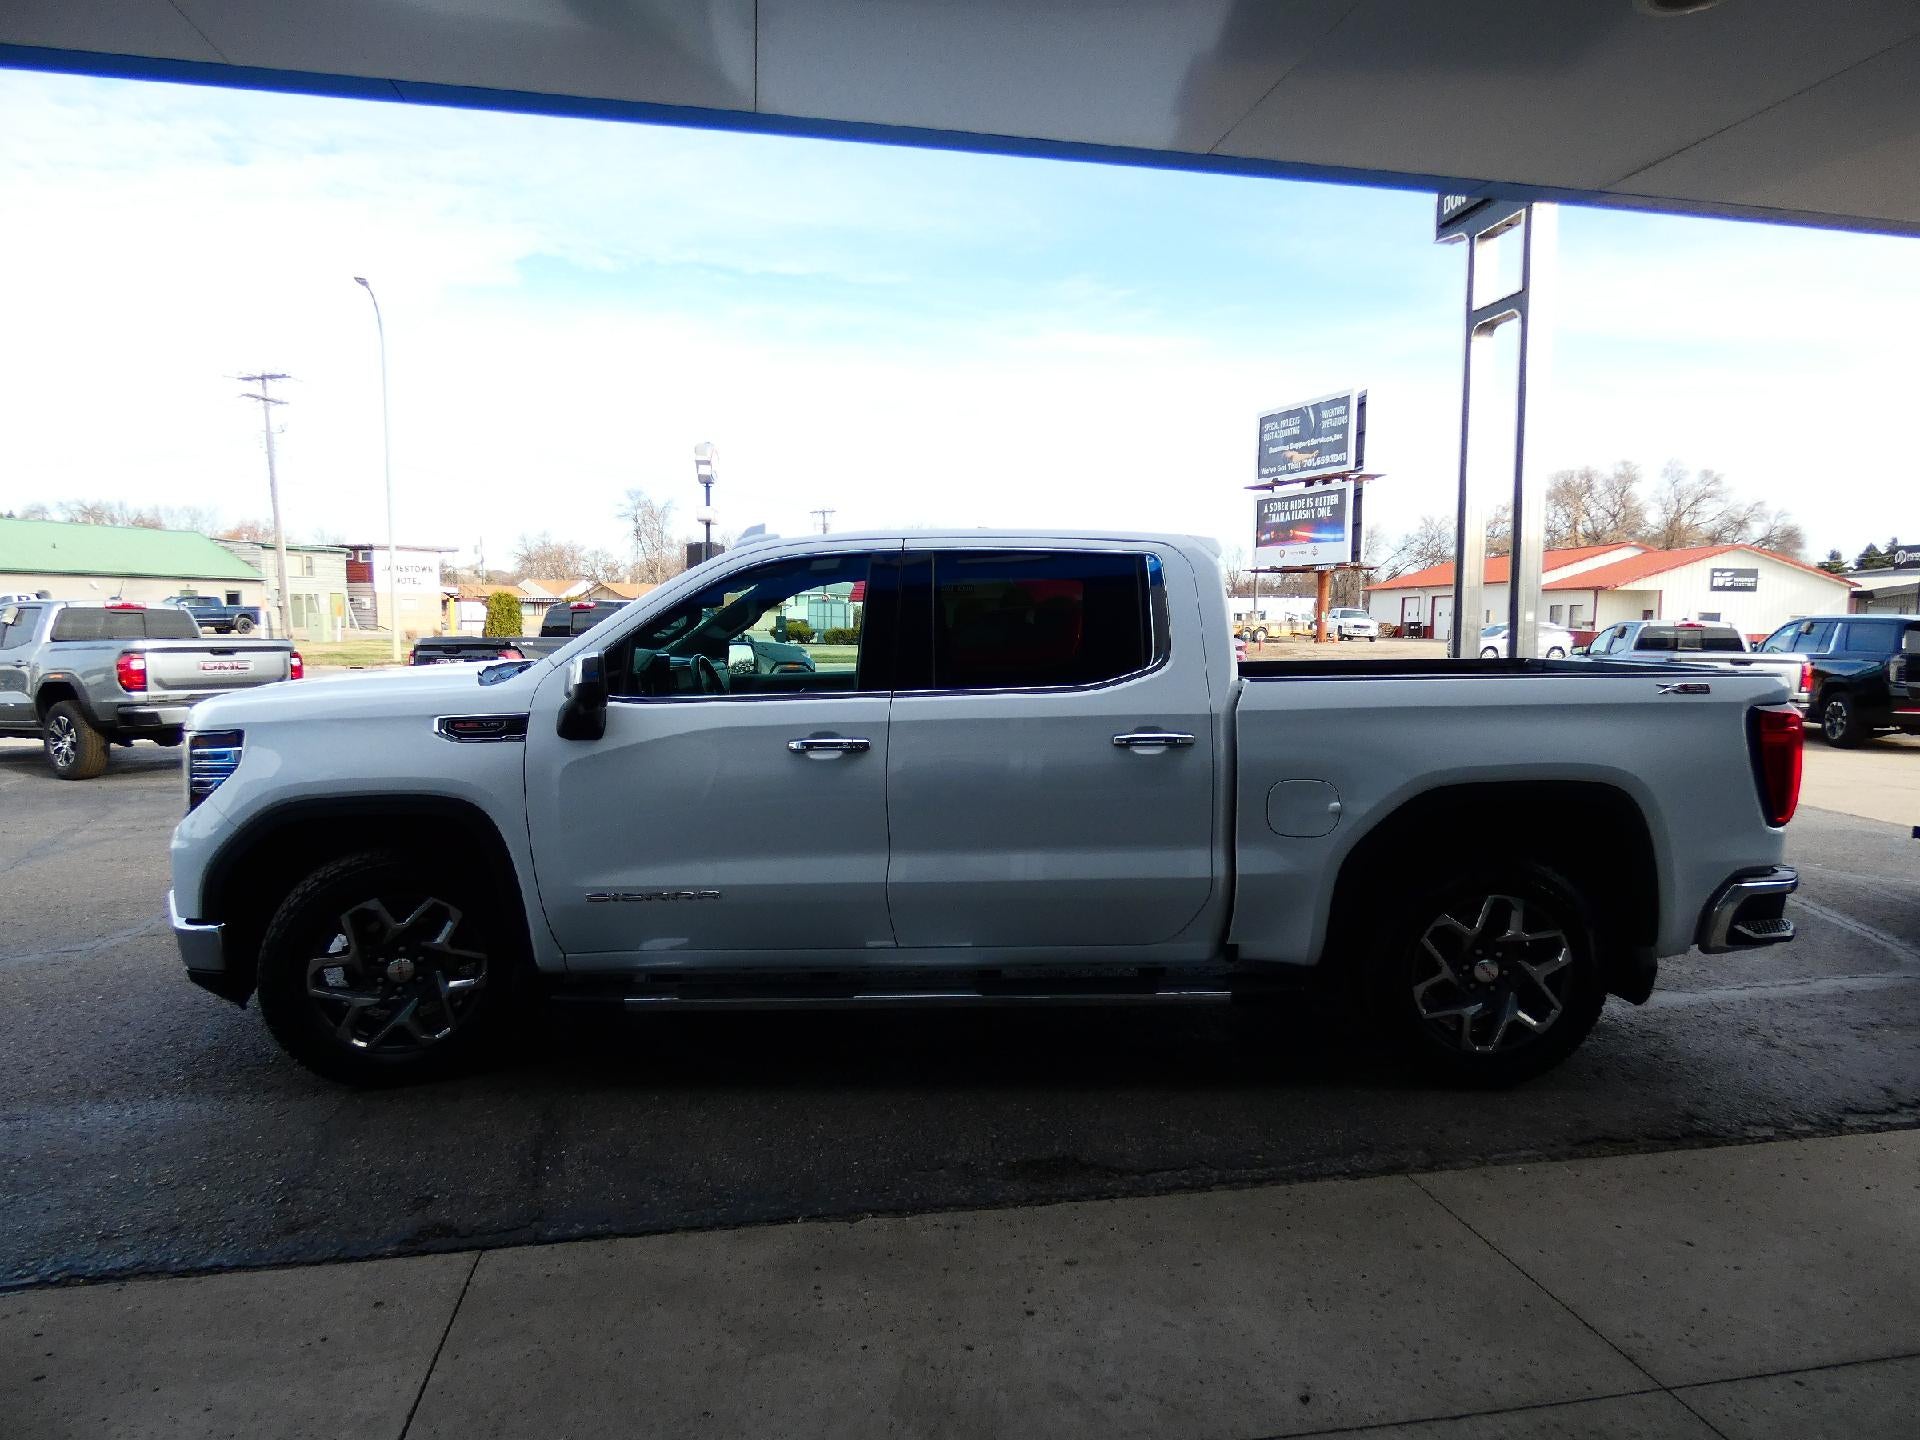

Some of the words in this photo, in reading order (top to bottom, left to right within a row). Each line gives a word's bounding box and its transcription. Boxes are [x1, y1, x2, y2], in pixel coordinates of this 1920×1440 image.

[1269, 500, 1289, 513] SOBER
[1290, 498, 1306, 510] RIDE
[1306, 497, 1314, 508] IS
[1315, 494, 1339, 507] BETTER
[382, 565, 433, 573] JAESTOWN
